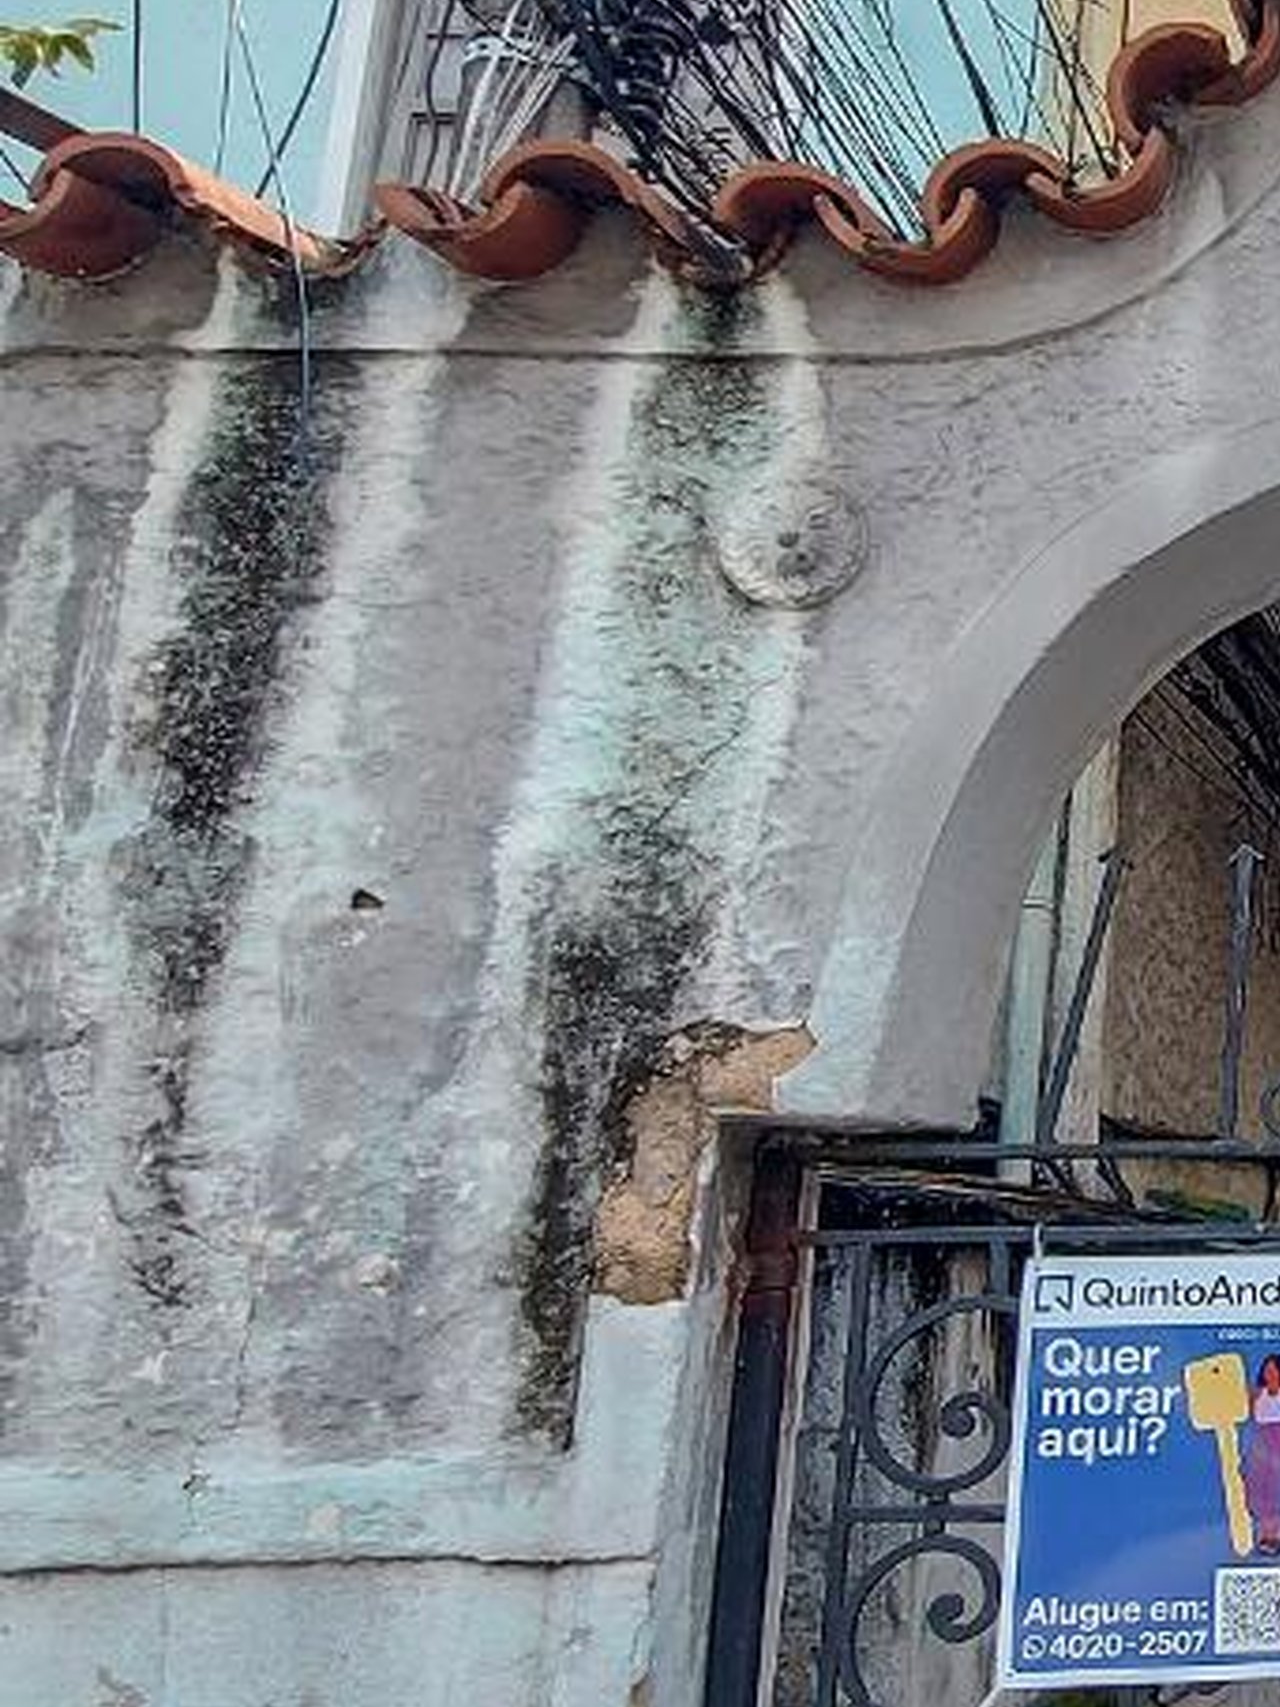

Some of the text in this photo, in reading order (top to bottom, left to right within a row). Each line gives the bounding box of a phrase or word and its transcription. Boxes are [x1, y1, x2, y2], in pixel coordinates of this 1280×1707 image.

[1045, 1337, 1160, 1377] Quer
[1042, 1386, 1181, 1416] morar
[1038, 1416, 1167, 1465] aqui?
[1023, 1597, 1209, 1631] Alugue em:
[1050, 1630, 1207, 1659] 4020-2507
